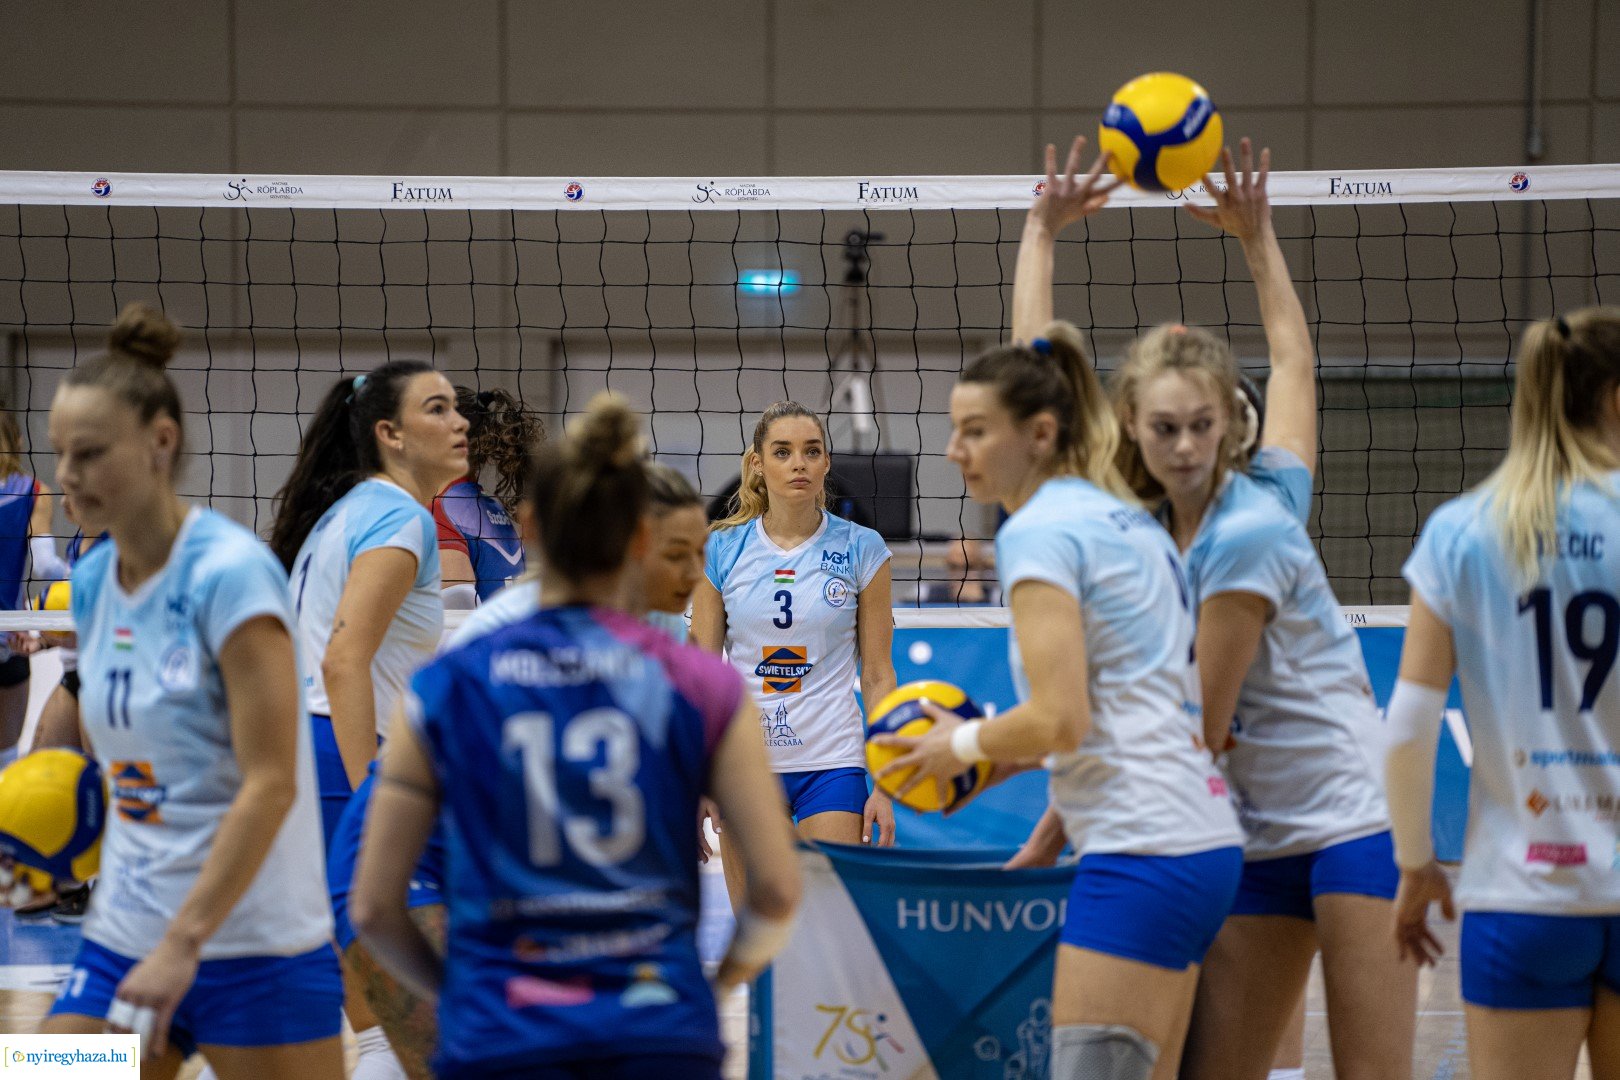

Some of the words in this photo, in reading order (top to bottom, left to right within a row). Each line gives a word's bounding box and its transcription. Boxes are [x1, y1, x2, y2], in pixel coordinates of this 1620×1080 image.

[820, 562, 850, 574] BANK
[772, 589, 793, 630] 3
[1517, 587, 1620, 713] 19
[105, 667, 132, 730] 11
[502, 706, 647, 868] 13
